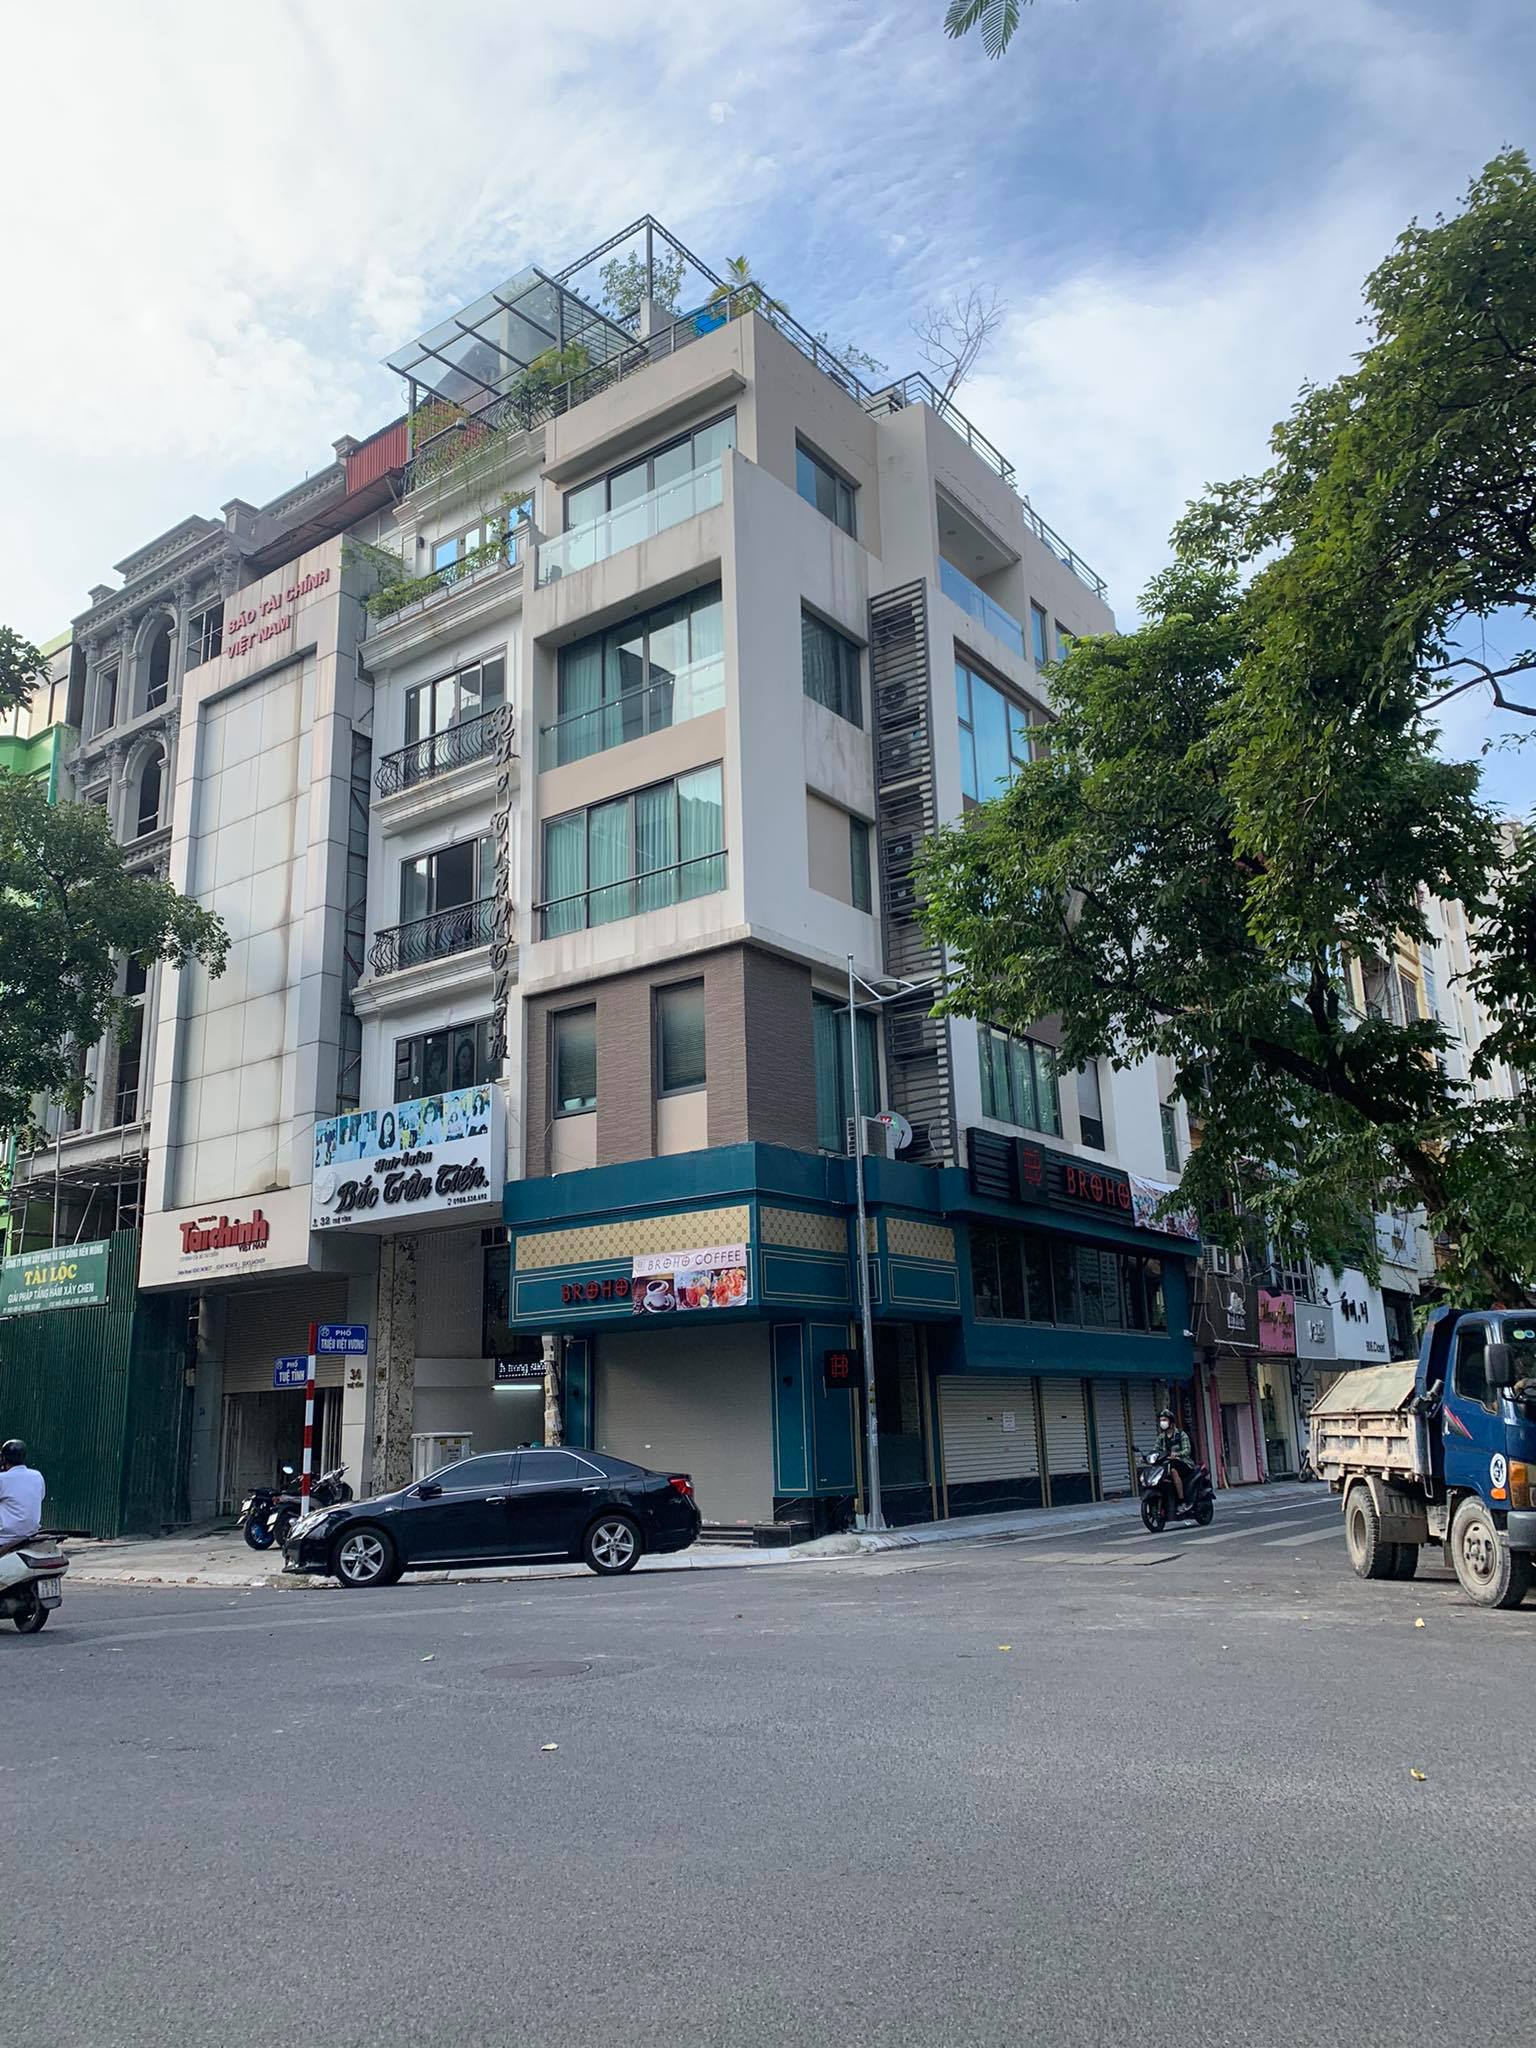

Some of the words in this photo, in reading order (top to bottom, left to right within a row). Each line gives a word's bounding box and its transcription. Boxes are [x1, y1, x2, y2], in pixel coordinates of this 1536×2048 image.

[228, 609, 257, 635] BÁO
[259, 593, 282, 617] TÀI
[286, 568, 330, 602] CHÍNH
[228, 633, 256, 659] VIỆT
[258, 614, 291, 643] NAM
[334, 1174, 379, 1214] Bắc
[383, 1169, 433, 1204] Trần
[1066, 1166, 1131, 1210] BROHO
[320, 1216, 331, 1226] 32
[238, 1242, 252, 1252] VIỆT
[252, 1241, 267, 1250] NAM
[647, 1255, 690, 1271] BROHO
[695, 1249, 742, 1266] COFFEE
[24, 1265, 47, 1286] TÀI
[50, 1260, 78, 1284] LỘC
[77, 1282, 94, 1294] CHEN
[561, 1277, 629, 1303] BROHO
[335, 1327, 352, 1336] PHỐ
[321, 1337, 335, 1351] TRIỆU
[336, 1337, 347, 1351] VIỆT
[348, 1338, 365, 1350] VƯƠNG
[286, 1359, 298, 1368] PHỐ
[279, 1369, 290, 1384] TUỆ
[291, 1368, 305, 1381] TĨNH
